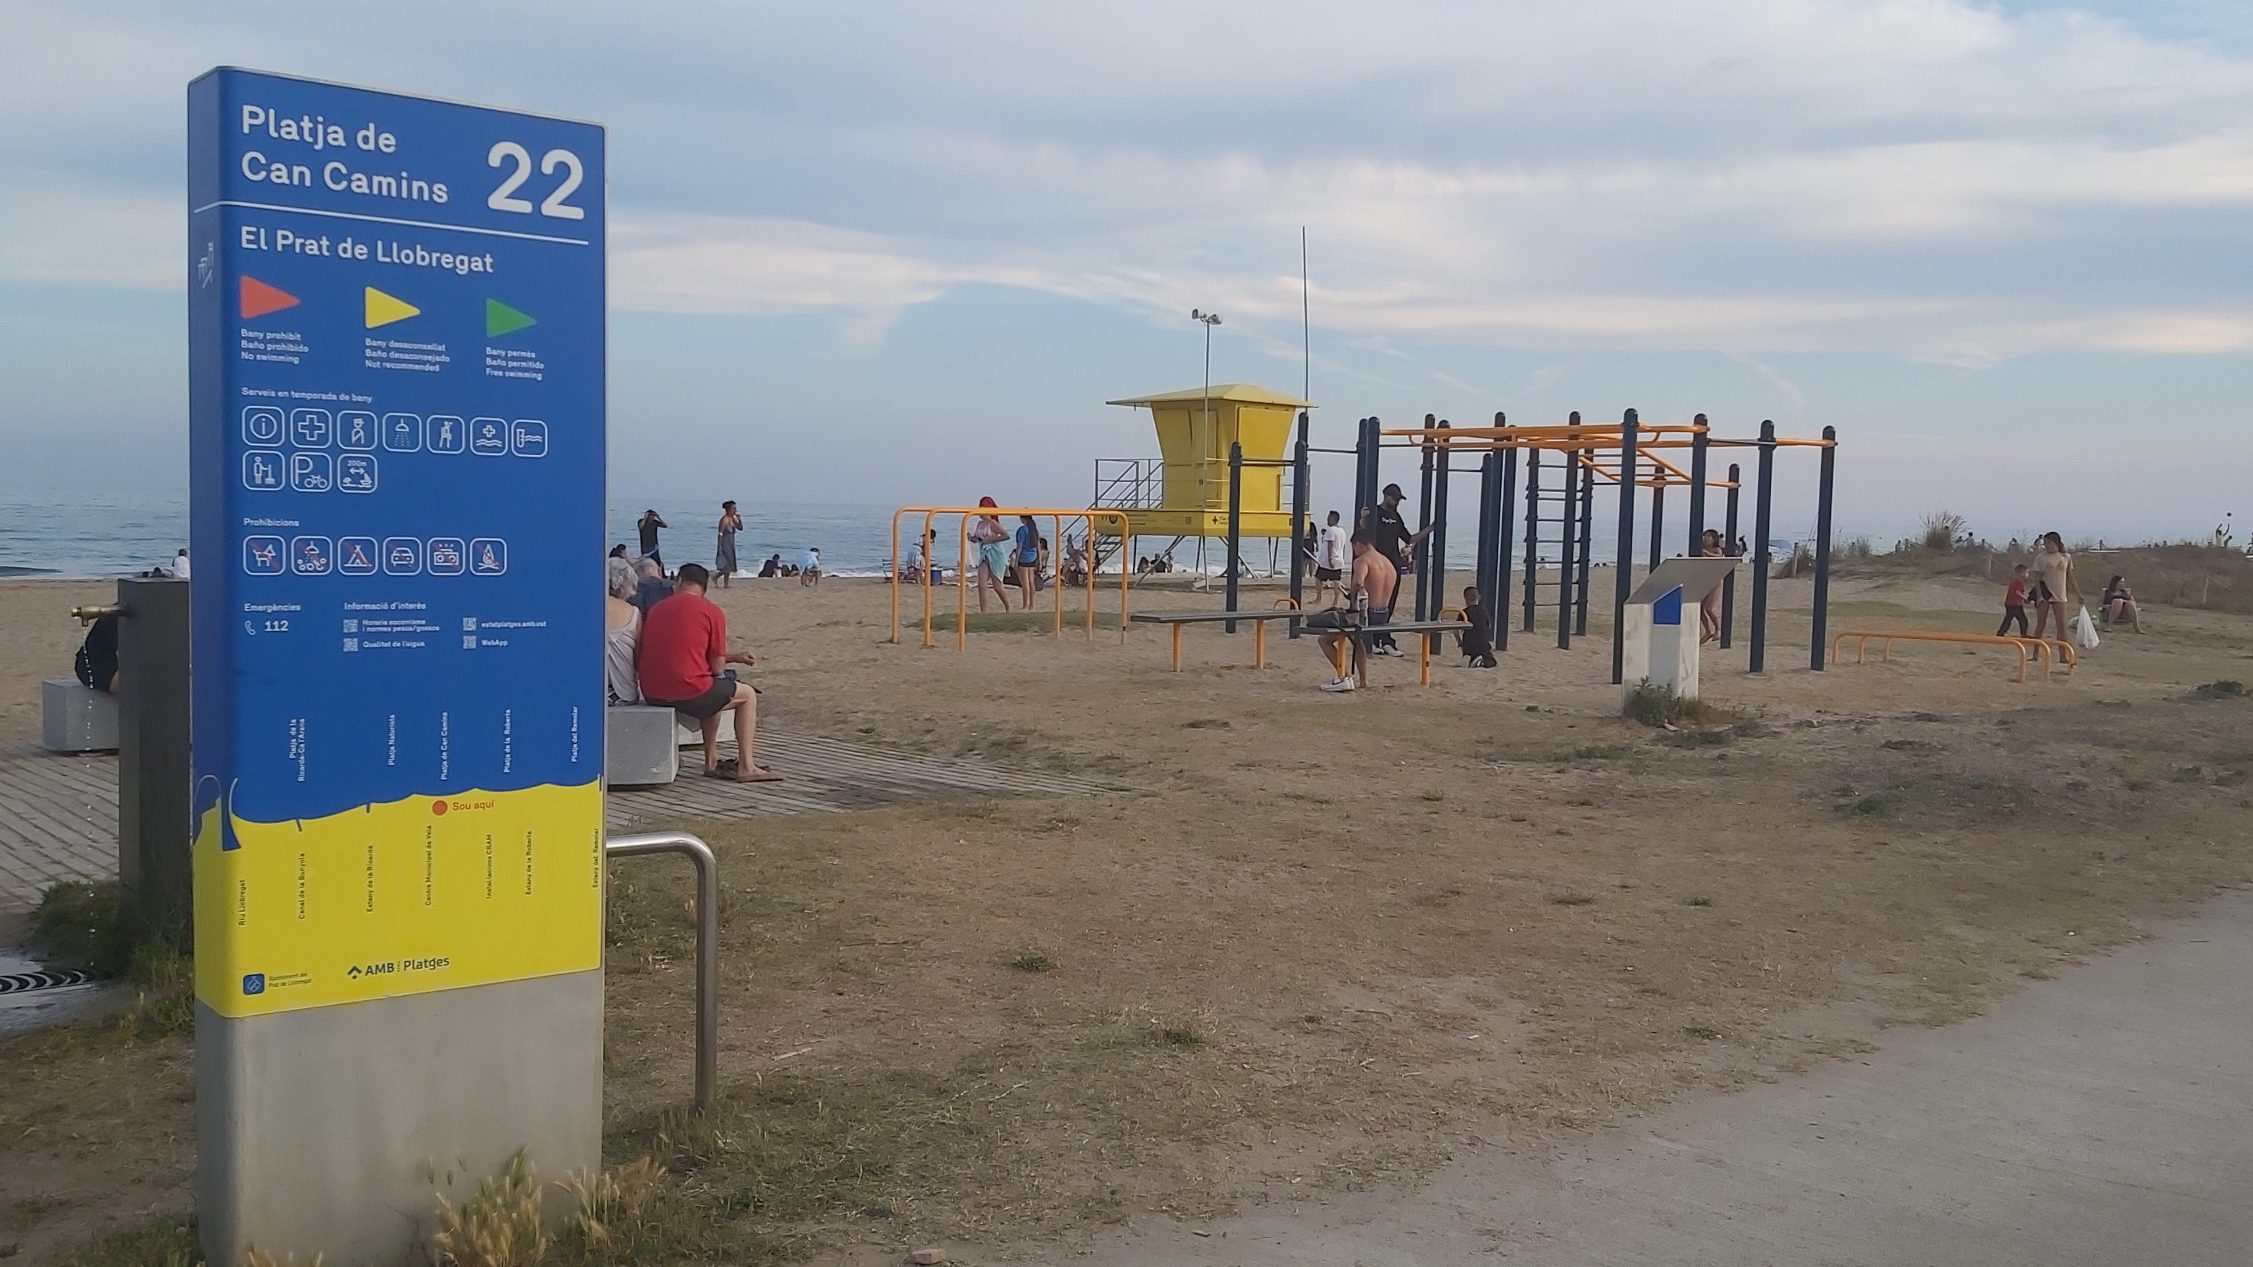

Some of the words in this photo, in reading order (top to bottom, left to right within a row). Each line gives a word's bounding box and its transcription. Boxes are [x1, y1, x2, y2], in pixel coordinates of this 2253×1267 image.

[241, 104, 347, 150] Platja
[356, 122, 397, 153] de
[241, 151, 311, 187] Can
[323, 161, 449, 204] Camins
[486, 141, 585, 221] 22
[241, 225, 268, 250] El
[276, 229, 331, 257] Prat
[337, 237, 369, 260] de
[377, 240, 494, 275] Llobregat
[241, 329, 264, 340] Bany
[266, 331, 301, 342] prohibit
[241, 340, 265, 350] Baño
[267, 342, 309, 353] prohibido
[365, 338, 387, 349] Bany
[388, 340, 446, 352] desaconsellat
[241, 351, 254, 360] No
[256, 354, 300, 365] swimming
[365, 349, 387, 359] Baño
[389, 350, 450, 363] desaconsejado
[486, 347, 506, 358] Bany
[365, 359, 381, 369] Not
[382, 361, 440, 373] recommended
[486, 357, 507, 367] Baño
[507, 359, 545, 370] permitido
[486, 368, 503, 378] Free
[505, 370, 543, 381] swimming
[241, 387, 276, 398] Serveis
[291, 391, 338, 401] temporada
[339, 393, 350, 401] de
[351, 393, 373, 404] bany
[243, 517, 300, 527] Prohibicions
[244, 603, 301, 613] Emergències
[344, 602, 389, 610] Informació
[264, 620, 289, 632] 112
[387, 714, 396, 746] Naturista
[440, 711, 448, 737] Camins
[289, 727, 297, 736] de
[288, 738, 298, 759] Platja
[440, 737, 448, 751] Can
[504, 744, 511, 753] de
[387, 746, 397, 766] Platja
[440, 752, 448, 760] de
[571, 743, 580, 763] Platja
[440, 760, 449, 780] Platja
[504, 753, 512, 773] Platja
[452, 801, 471, 811] Sou
[473, 799, 495, 811] aquí
[425, 841, 431, 849] de
[525, 864, 532, 873] de
[366, 880, 373, 889] de
[525, 874, 533, 895] Estany
[238, 879, 247, 912] Llobregat
[298, 890, 305, 898] de
[366, 890, 374, 913] Estany
[238, 913, 246, 926] Riu
[364, 962, 395, 977] AMB
[403, 957, 451, 973] Platges
